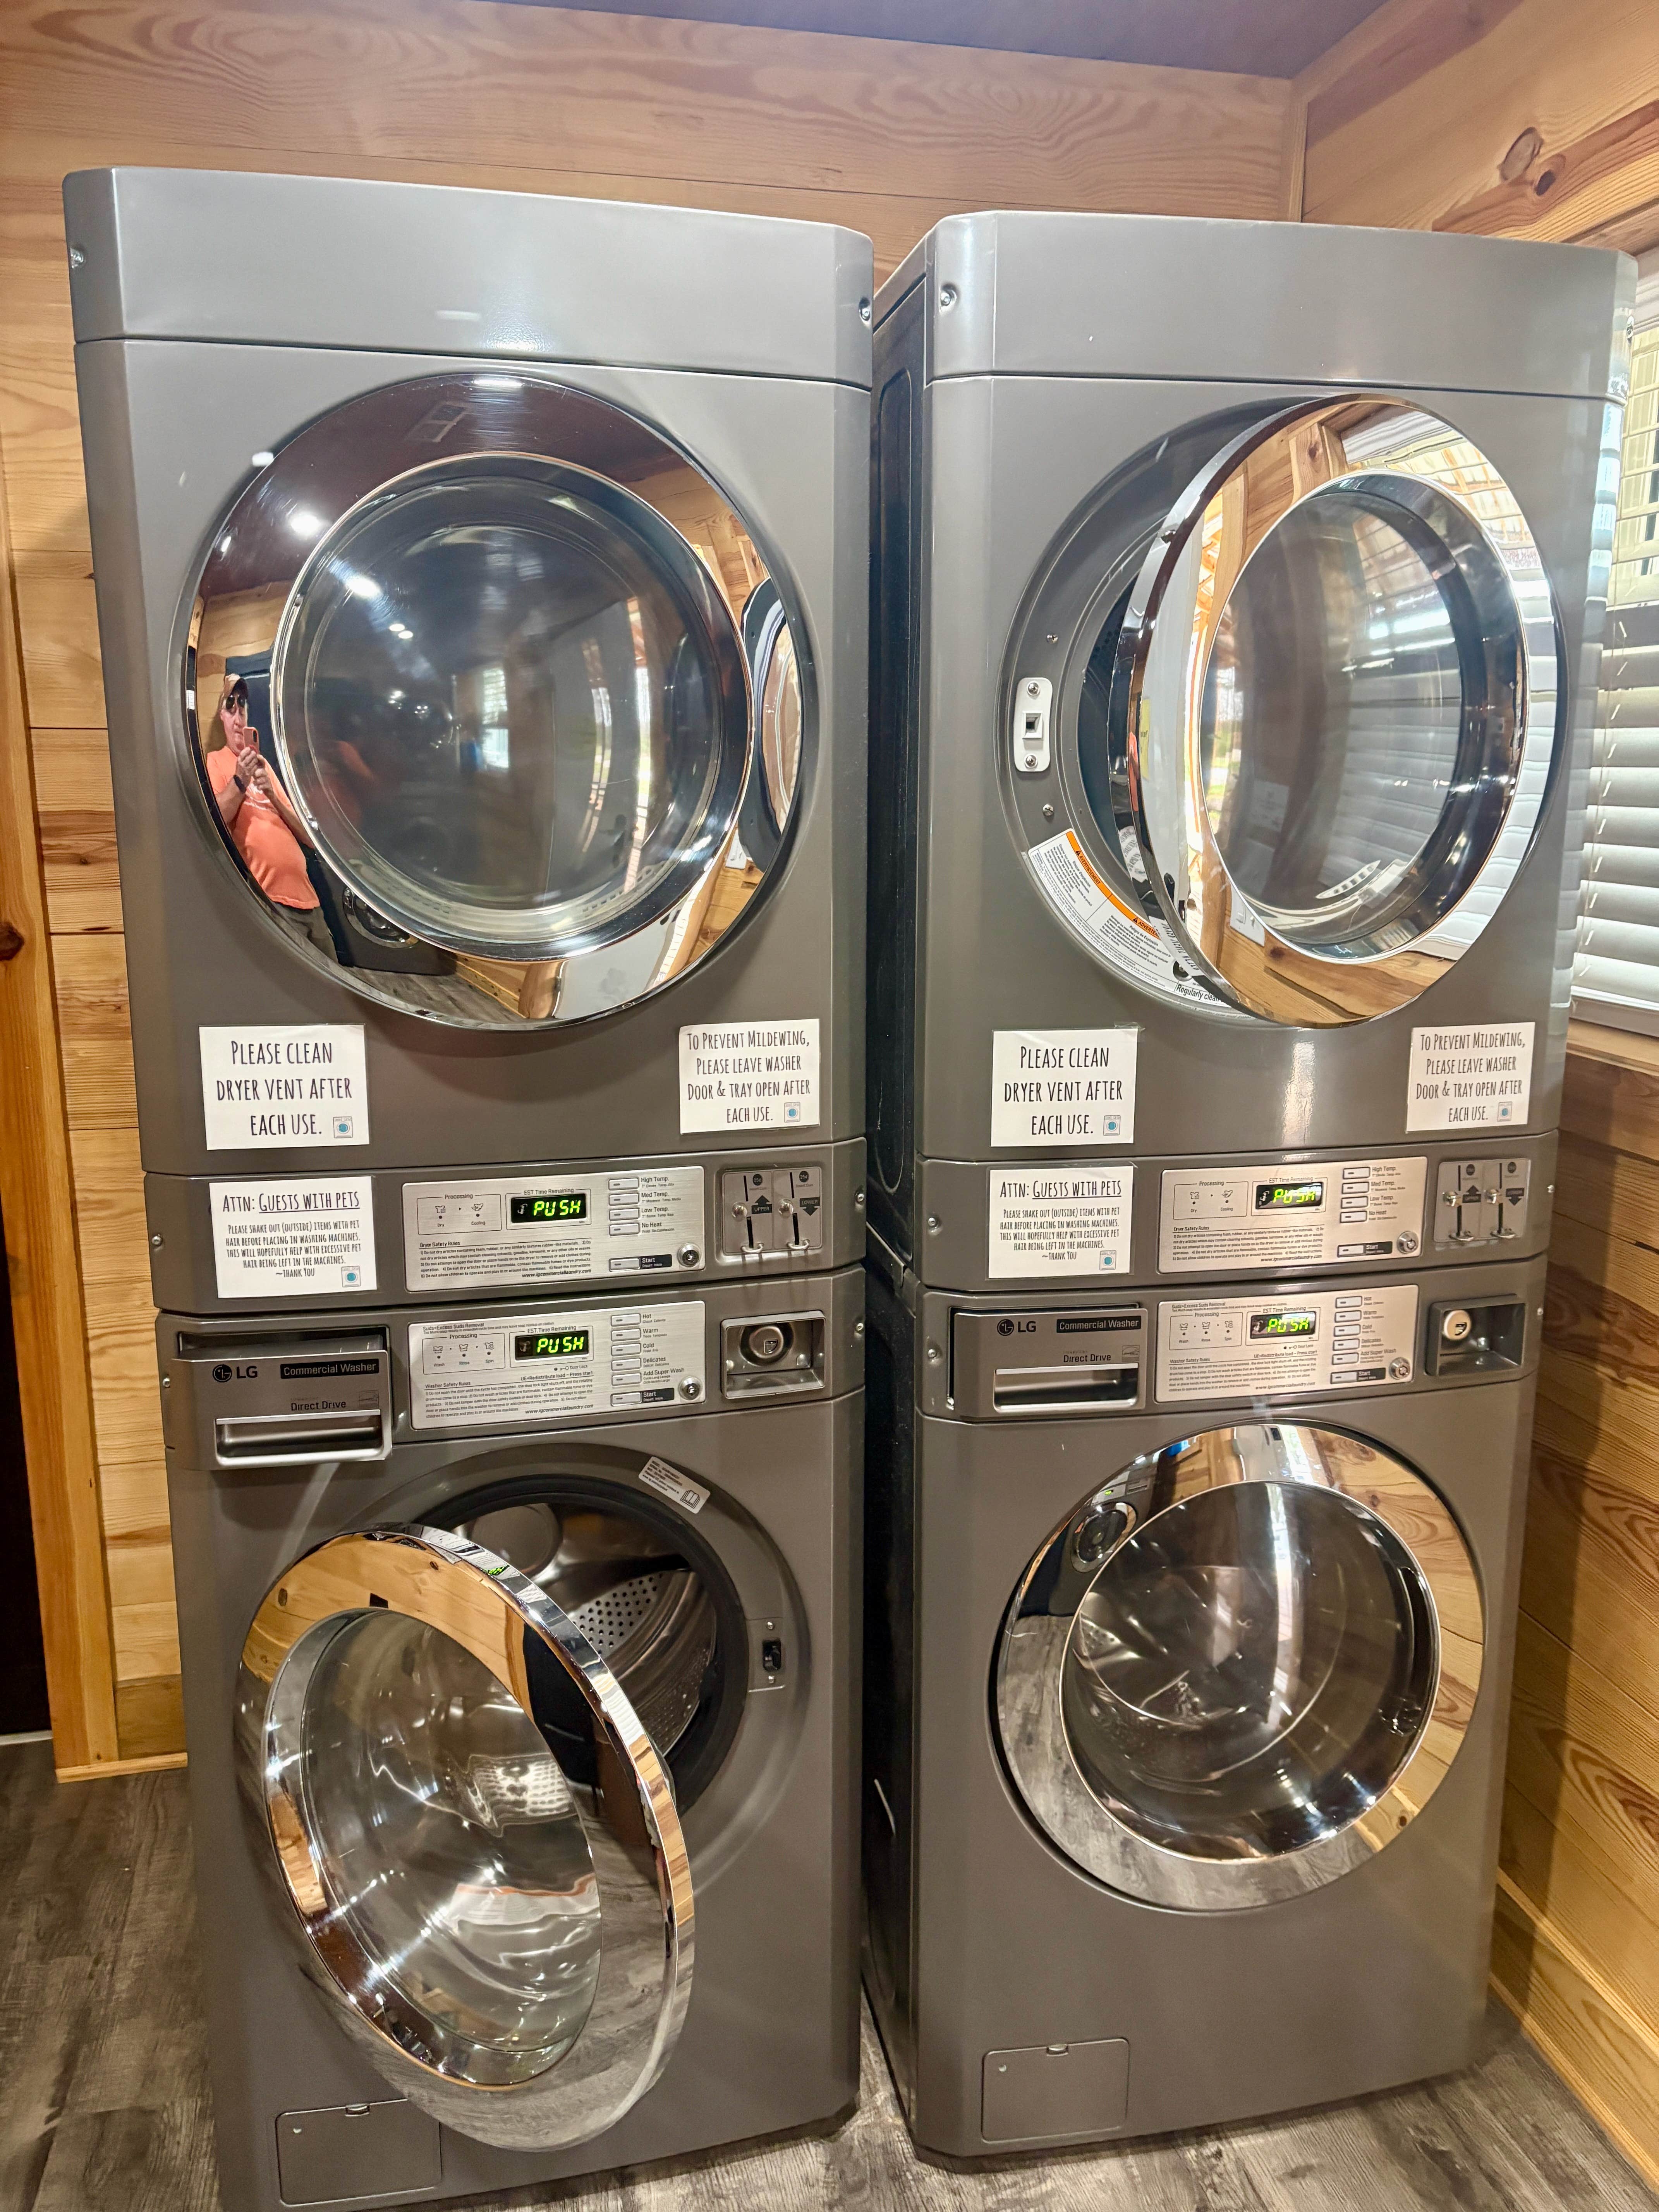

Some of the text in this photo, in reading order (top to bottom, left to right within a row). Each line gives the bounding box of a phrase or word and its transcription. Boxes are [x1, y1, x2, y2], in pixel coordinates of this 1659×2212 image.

[1080, 856, 1101, 884] AVERTISSEMENT
[1176, 984, 1203, 1000] Regularly
[687, 1030, 809, 1050] TO PREVENT MILDEWING,
[1421, 1032, 1525, 1050] TO PREVENT MILDEWING,
[231, 1041, 331, 1064] PLEASE CLEAN
[1021, 1046, 1109, 1068] PLEASE CLEAN
[697, 1056, 801, 1075] PLEASE LEAVE WASHER
[1427, 1056, 1516, 1075] PLEASE LEAVE WASHER
[217, 1078, 352, 1101] DRYER VENT AFTER
[688, 1080, 810, 1100] DOOR & TRAY OPEN AFTER
[1005, 1080, 1122, 1102] DRYER VENT AFTER
[1416, 1080, 1522, 1099] DOOR & TRAY OPEN AFTER
[727, 1107, 773, 1123] EACH USE.
[1449, 1106, 1488, 1122] EACH USE.
[251, 1114, 321, 1135] EACH USE.
[1032, 1115, 1093, 1135] EACH USE.
[1000, 1180, 1121, 1197] ATTN: GUESTS WITH PETS
[223, 1192, 359, 1212] ATTN: GUESTS WITH PETS
[534, 1200, 581, 1216] PUSH
[1004, 1209, 1020, 1218] PLEASE
[1052, 1207, 1078, 1219] (OUTSIDE)
[228, 1220, 359, 1234] PLEASE SHAKE OUT (OUTSIDE) ITEMS WITH PET
[1034, 1221, 1056, 1229] PLACING
[1066, 1220, 1090, 1228] WASHING
[1092, 1219, 1119, 1227] MACHINES.
[226, 1233, 360, 1246] HAIR BEFORE PLACING IN WASHING MACHINES.
[1070, 1231, 1082, 1239] WITH
[1084, 1230, 1109, 1238] EXCESSIVE
[227, 1243, 361, 1257] THIS WILL HOPEFULLY HELP WITH EXCESSIVE PET
[1077, 1240, 1104, 1249] MACHINES.
[243, 1260, 258, 1268] HAIR
[259, 1259, 276, 1267] BEING
[278, 1258, 290, 1267] LEFT
[293, 1258, 300, 1266] IN
[314, 1255, 346, 1265] MACHINES.
[1067, 1251, 1077, 1260] YOU
[304, 1268, 314, 1276] YOU
[1018, 1321, 1036, 1333] LG
[1060, 1319, 1139, 1330] Commercial Washer
[537, 1336, 584, 1353] PUSH
[237, 1366, 258, 1379] LG
[284, 1363, 376, 1376] Commercial Washer
[291, 1401, 346, 1411] Direct Drive
